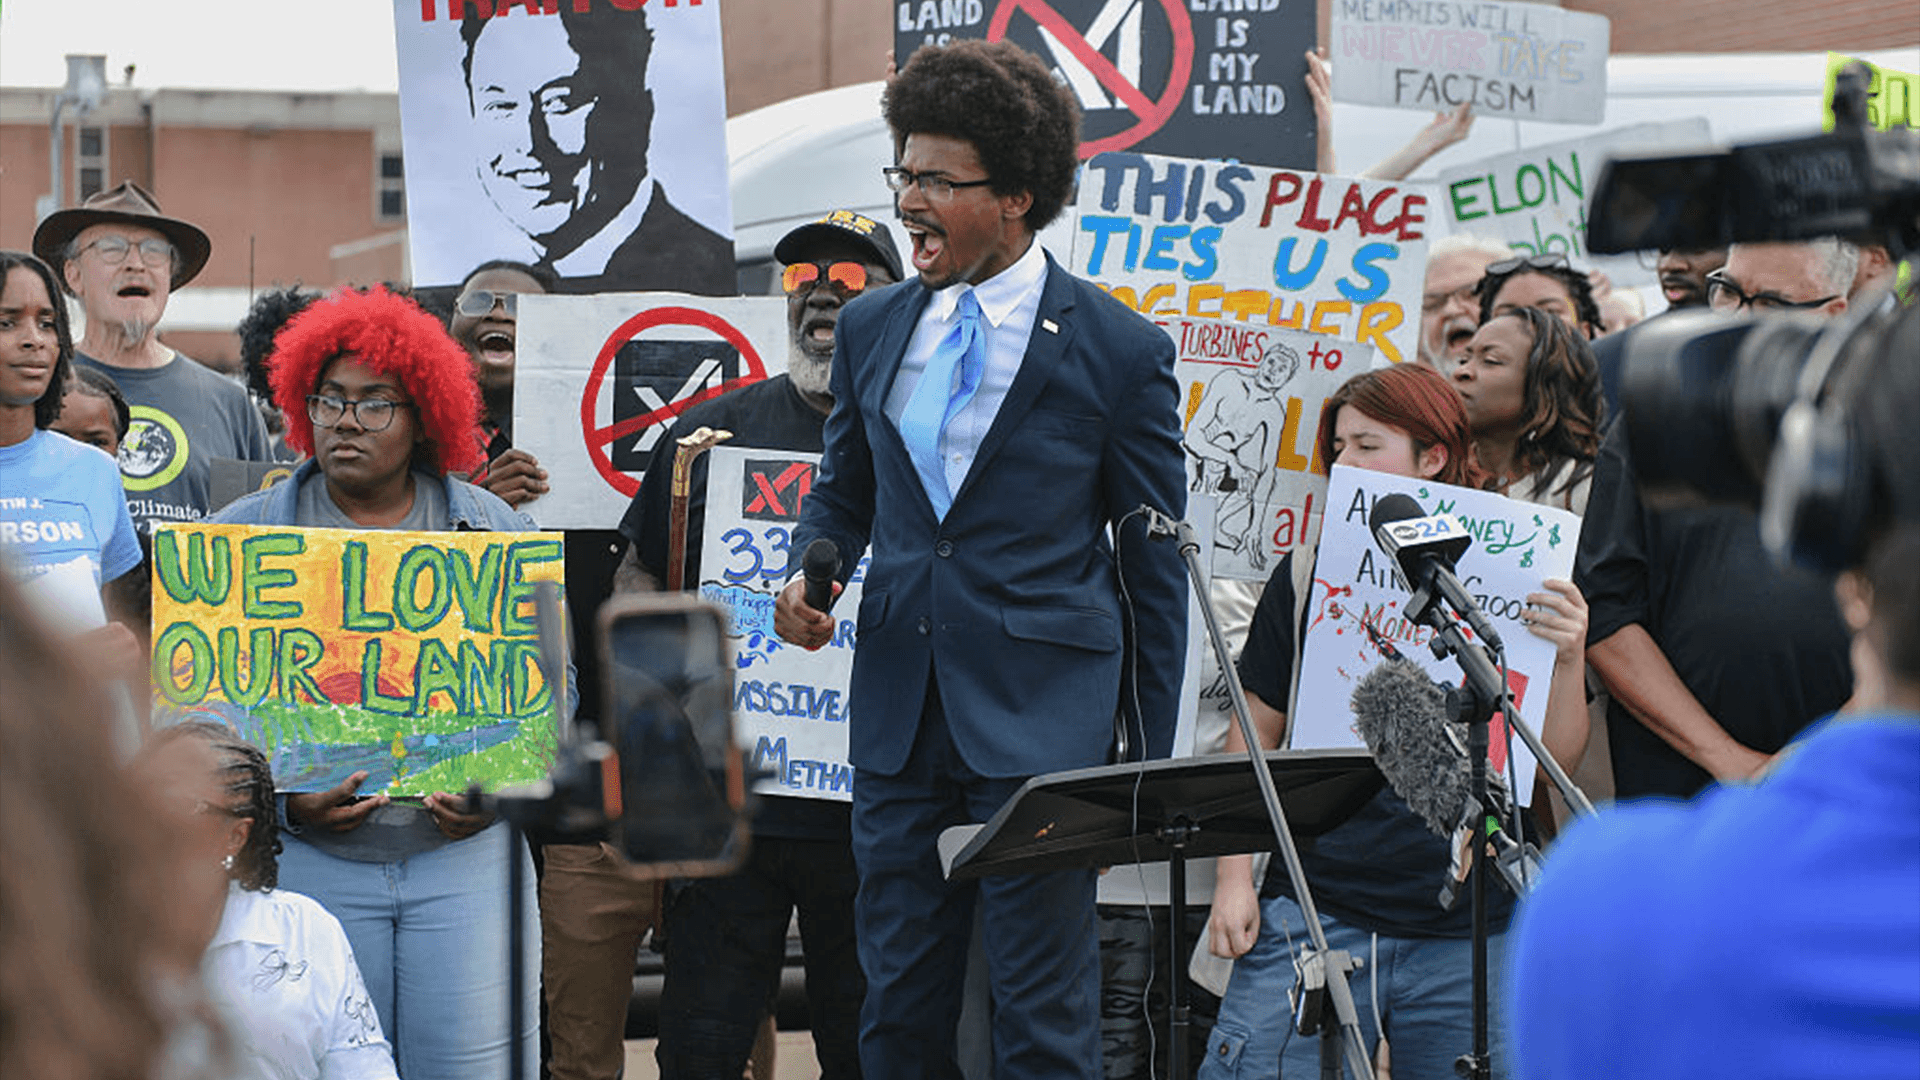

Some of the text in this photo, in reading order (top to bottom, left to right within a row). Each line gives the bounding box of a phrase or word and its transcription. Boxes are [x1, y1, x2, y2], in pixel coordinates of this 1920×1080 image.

[899, 0, 983, 32] LAND
[1215, 17, 1250, 48] IS
[1341, 0, 1538, 36] MEMPHIS WILL
[1209, 53, 1260, 82] MY
[1341, 25, 1586, 84] NEVER TAKE
[1193, 85, 1286, 115] LAND
[1394, 68, 1536, 113] FACISM
[1089, 152, 1427, 242] THIS PLACE
[1450, 152, 1584, 221] ELON
[1081, 215, 1400, 304] TIES US
[1179, 321, 1343, 371] TURBINES to
[126, 499, 201, 520] Climate
[155, 529, 563, 636] WE LOVE
[154, 621, 554, 718] OUR LAND
